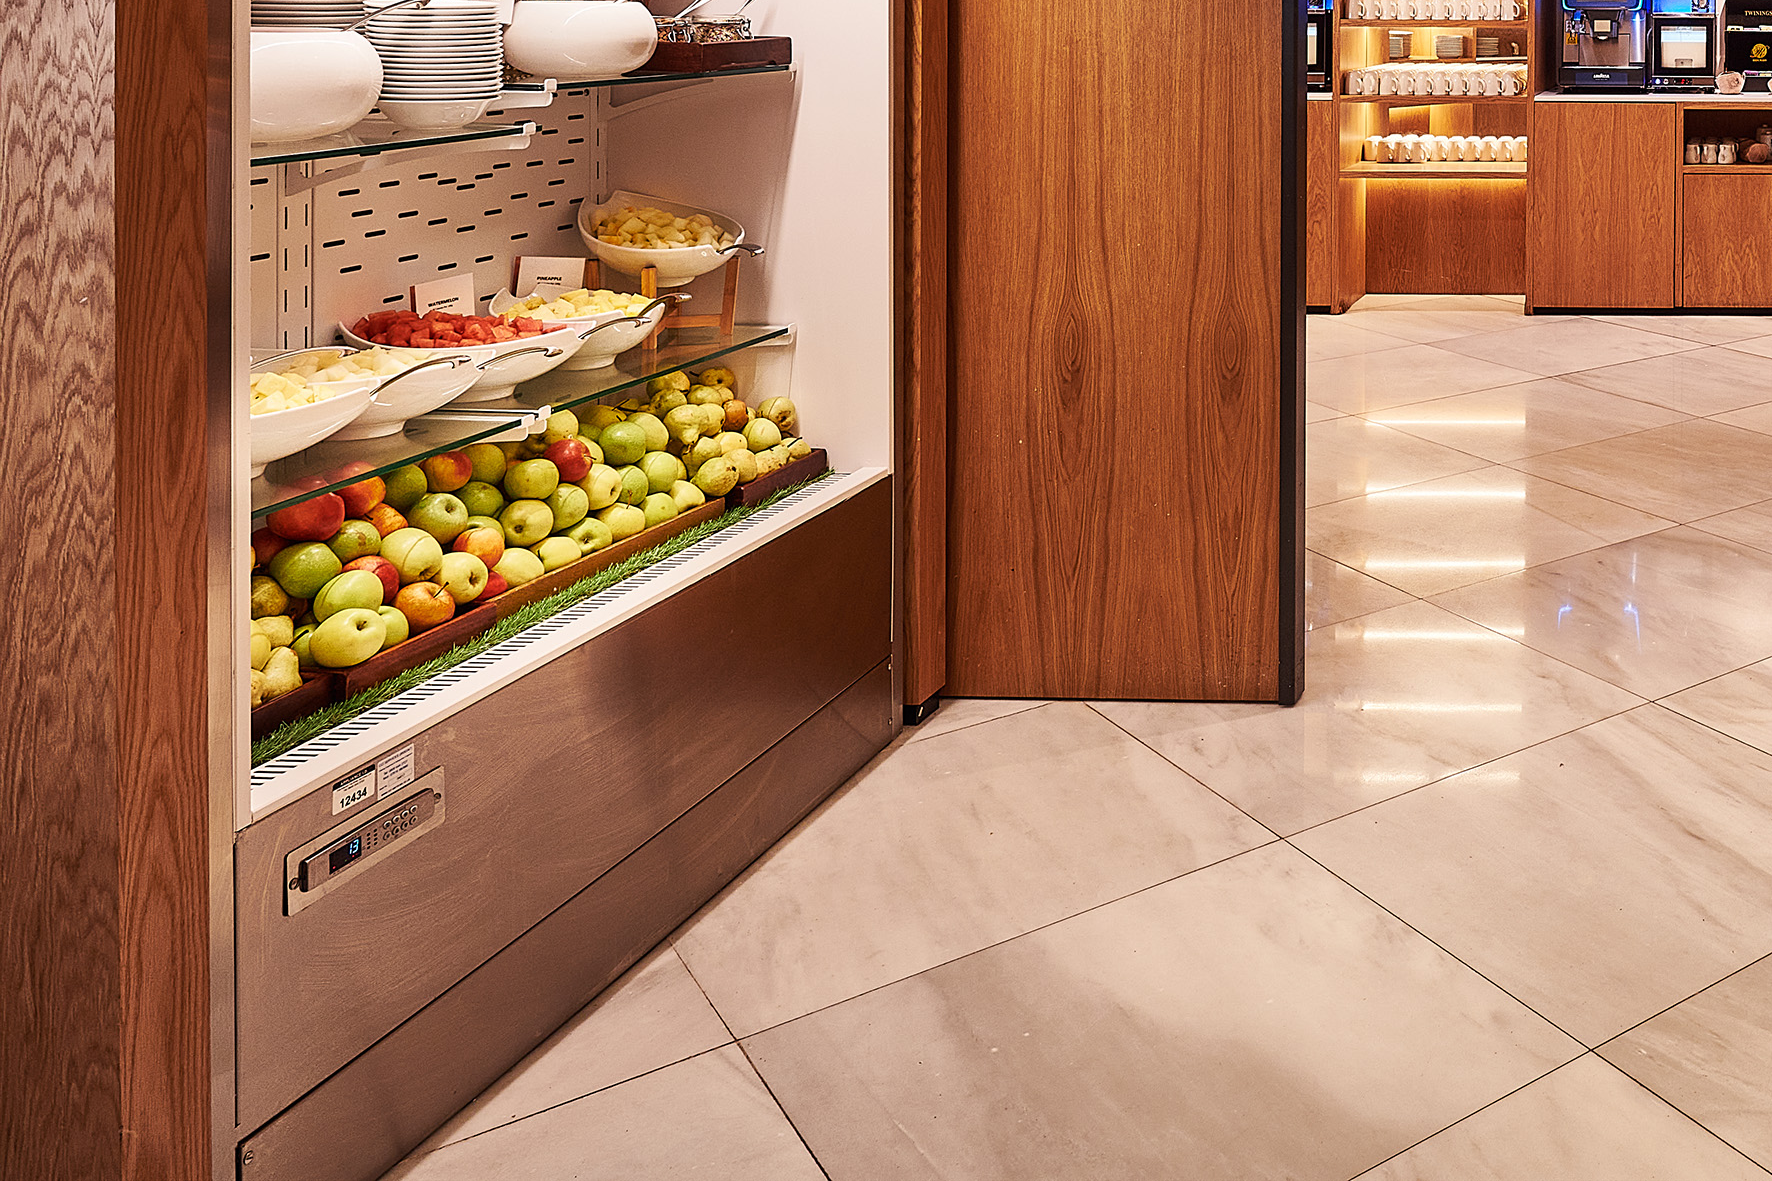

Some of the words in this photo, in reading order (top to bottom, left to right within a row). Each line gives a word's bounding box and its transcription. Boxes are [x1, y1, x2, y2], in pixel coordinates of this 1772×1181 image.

[428, 297, 459, 307] WATERMELON
[339, 786, 368, 809] 12434
[349, 838, 359, 855] 13
